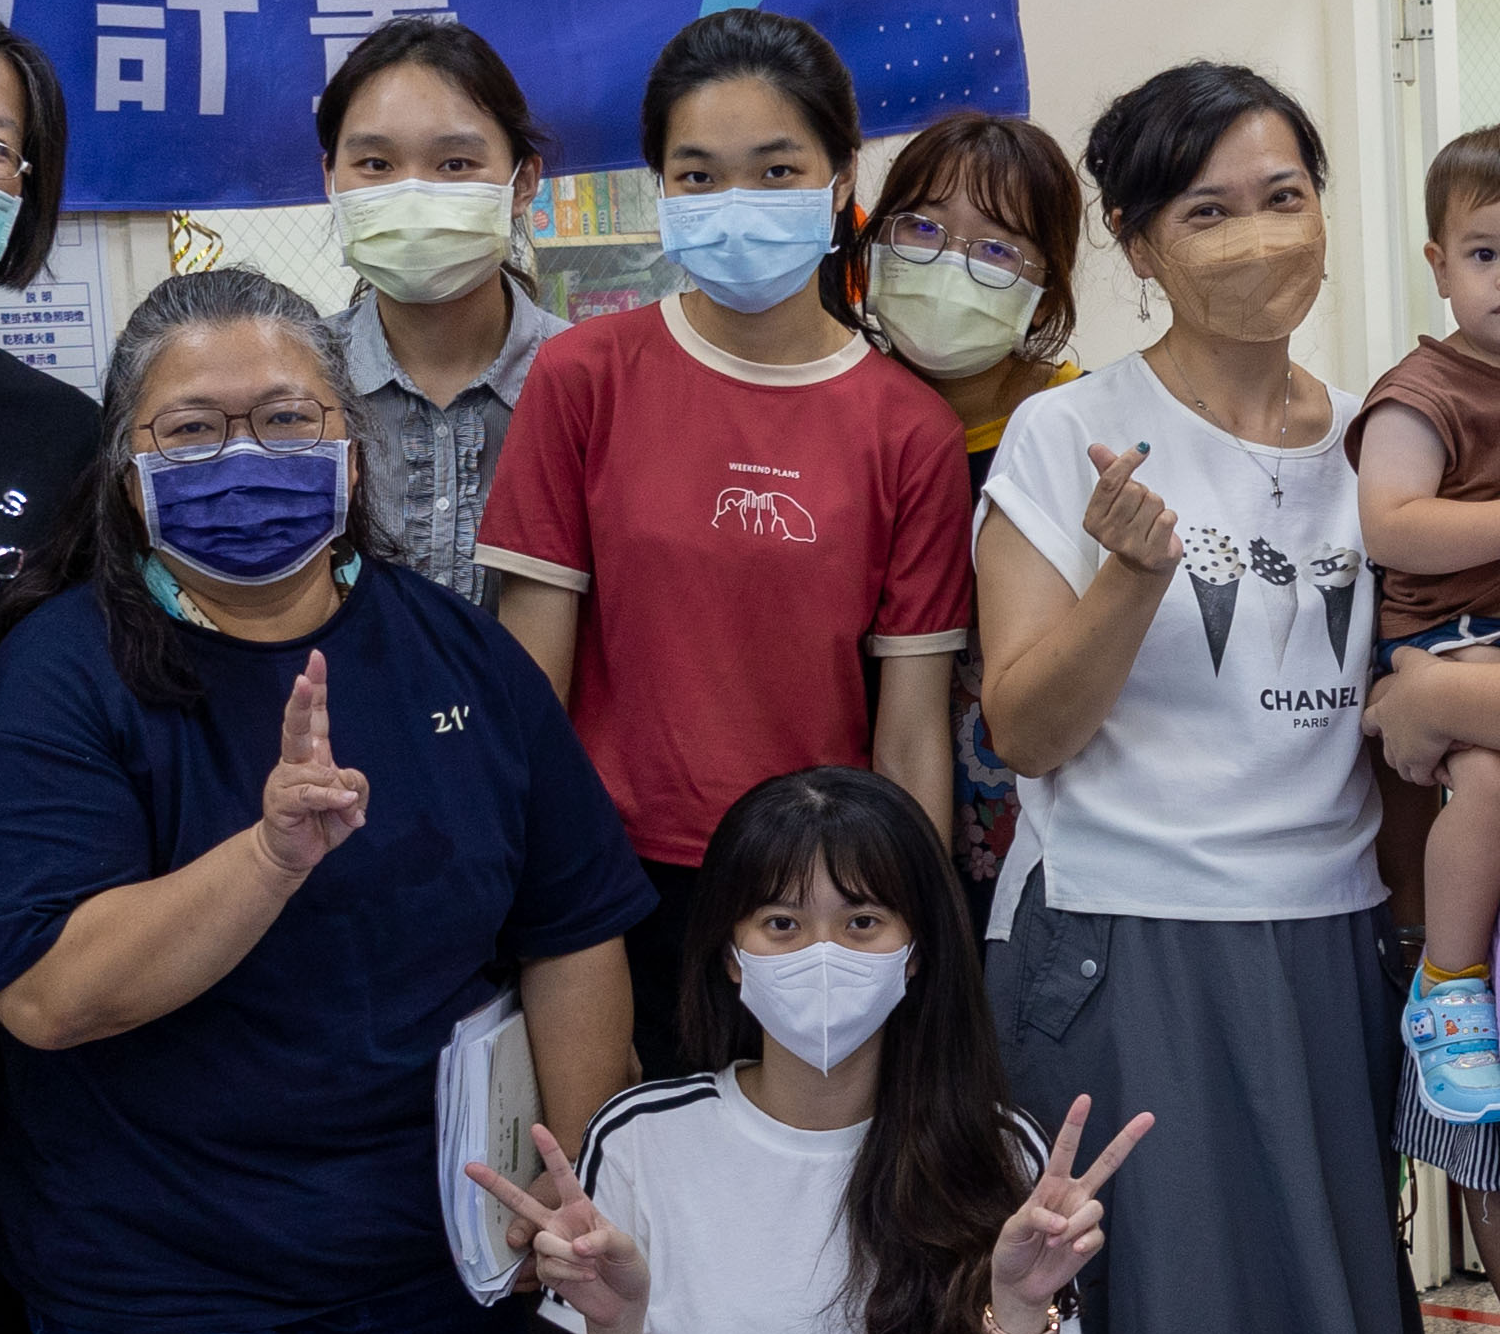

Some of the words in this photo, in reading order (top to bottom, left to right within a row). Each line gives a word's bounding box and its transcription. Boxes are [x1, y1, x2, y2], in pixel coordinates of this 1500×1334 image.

[728, 462, 771, 475] WEEKEND
[772, 467, 800, 479] PLANS
[1260, 686, 1358, 712] CHANEL
[1293, 717, 1329, 728] PARIS
